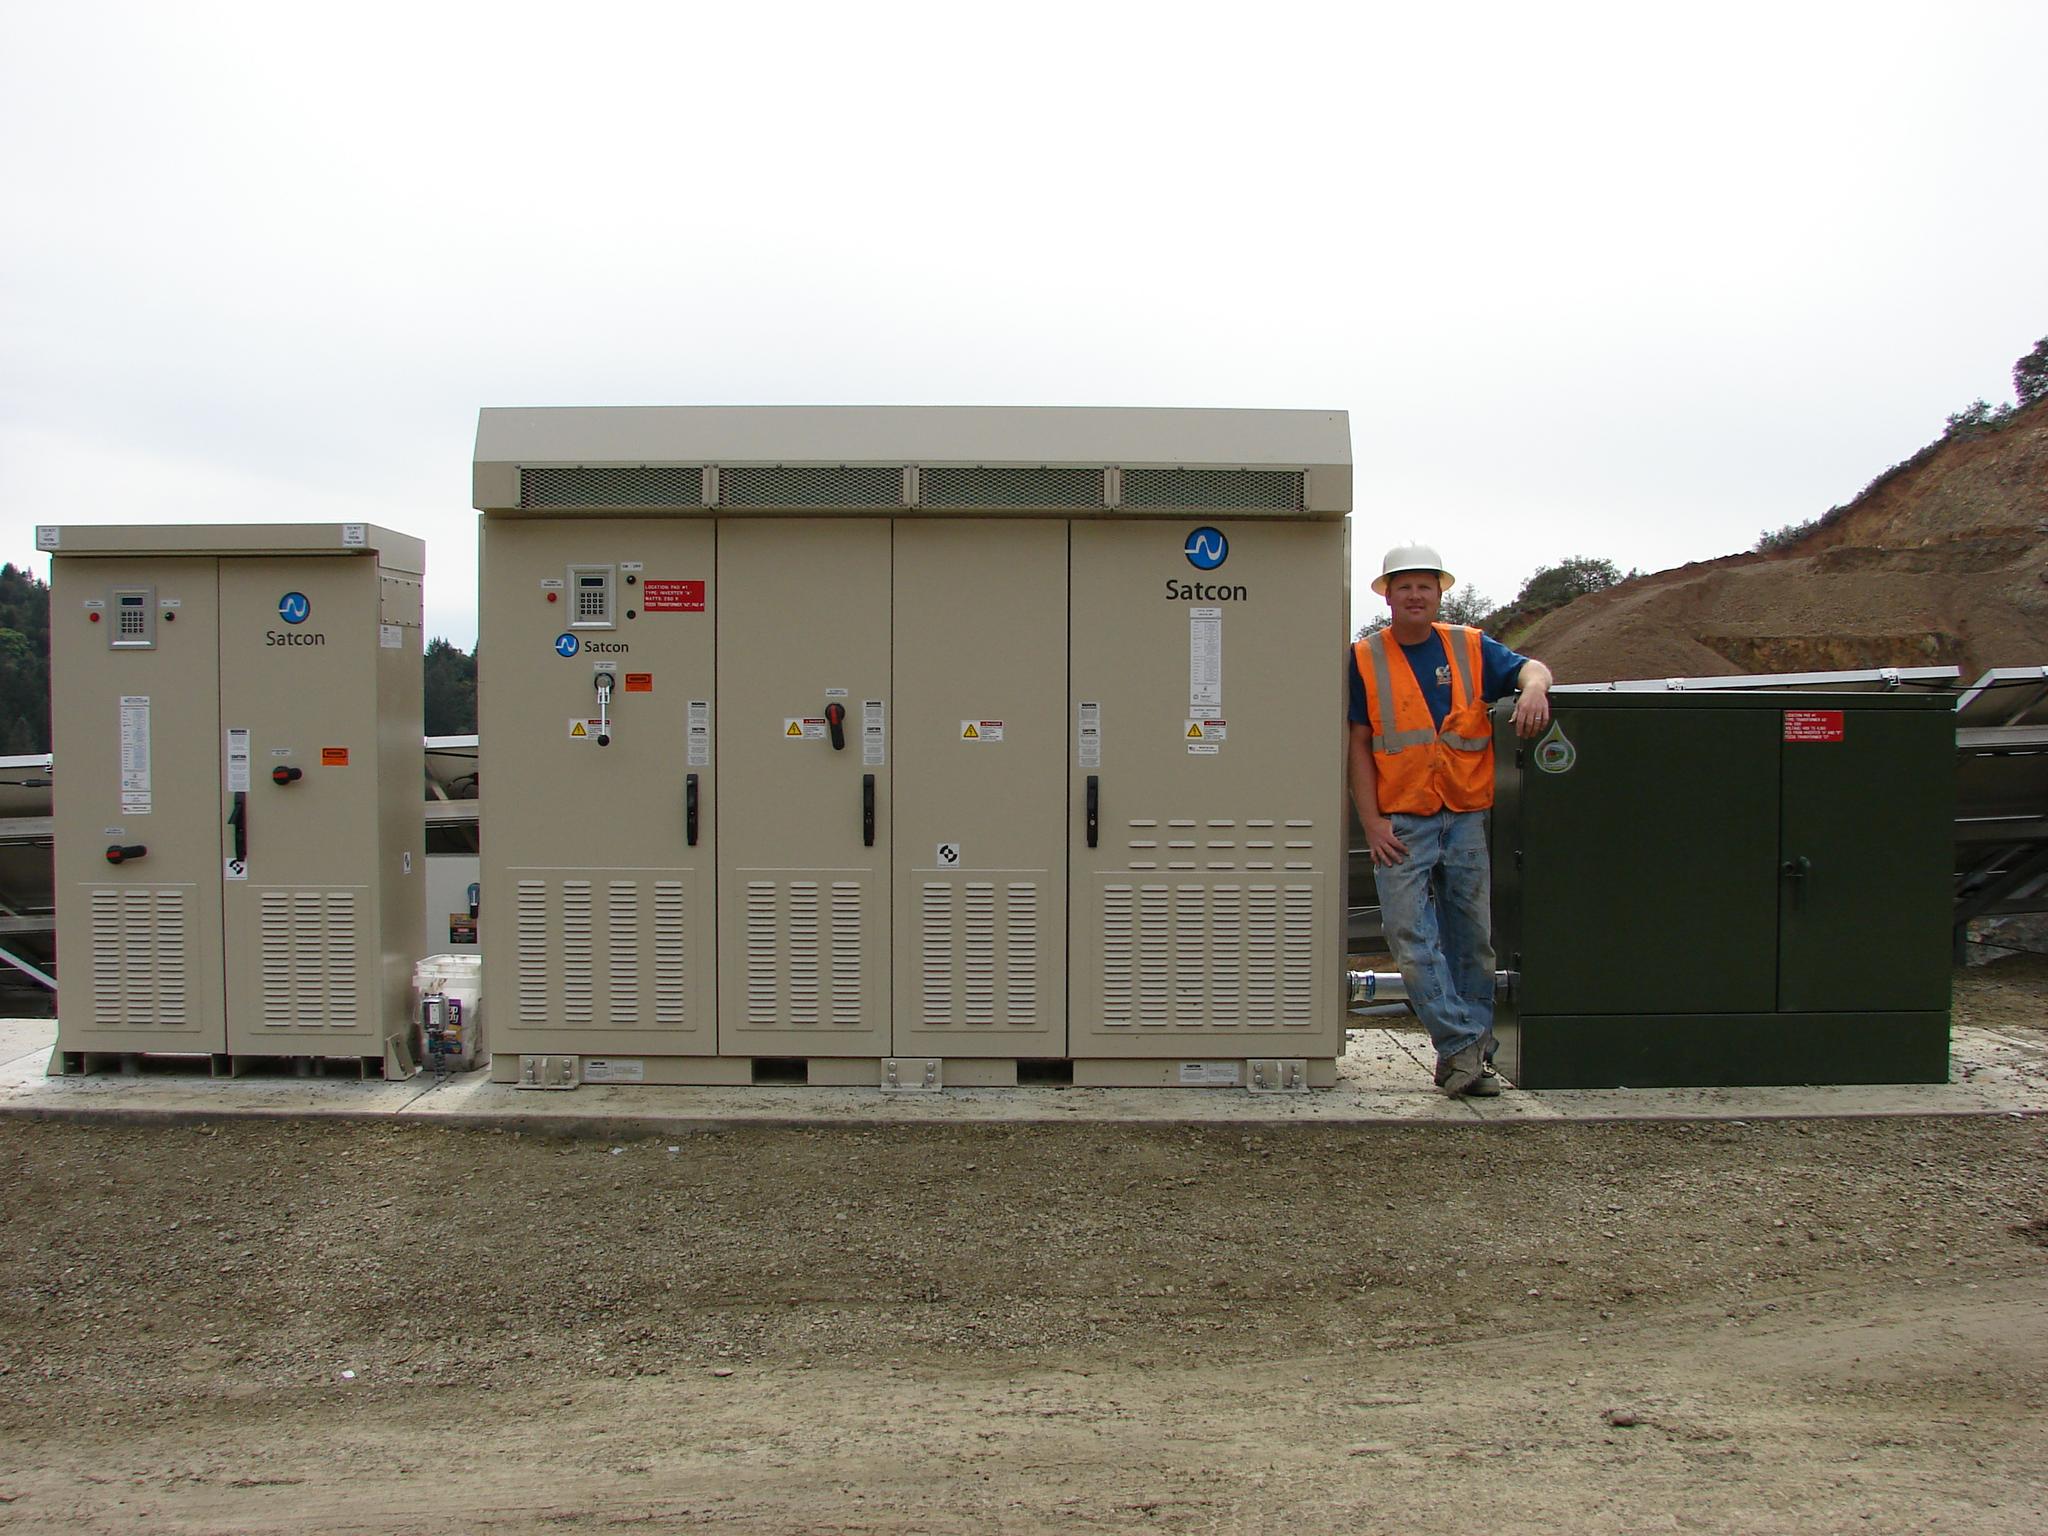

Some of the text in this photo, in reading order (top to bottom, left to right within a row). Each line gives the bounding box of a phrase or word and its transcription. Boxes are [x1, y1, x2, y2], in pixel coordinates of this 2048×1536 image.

[1166, 580, 1247, 601] Satcon
[267, 631, 324, 647] Satcon
[585, 641, 629, 653] Satcon
